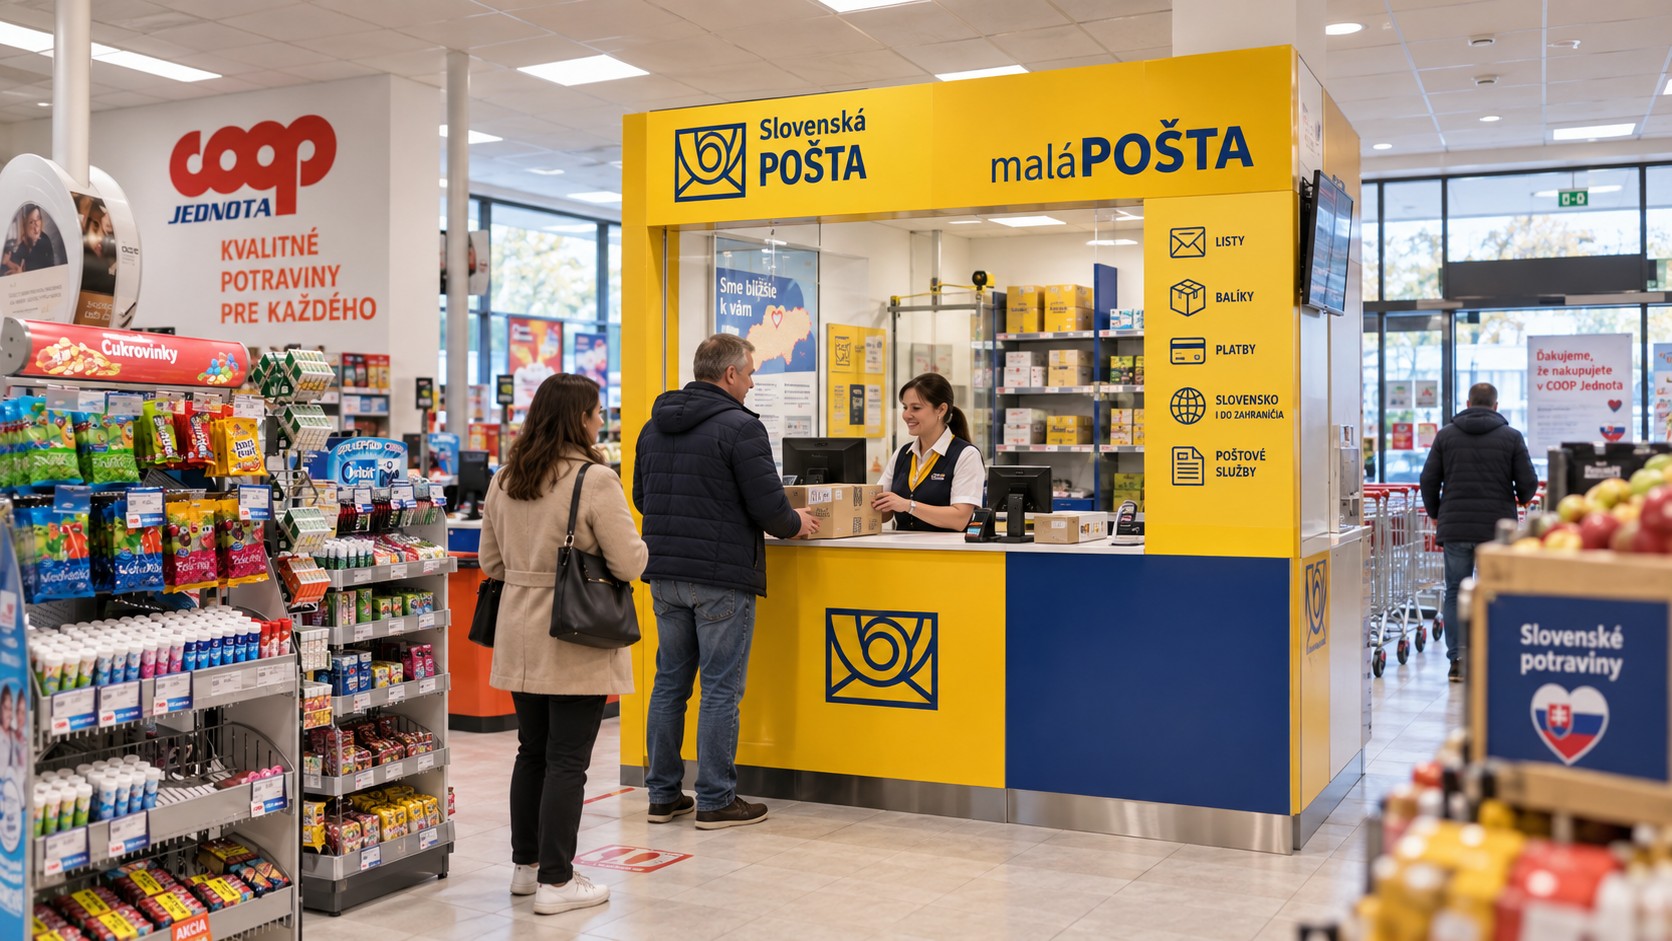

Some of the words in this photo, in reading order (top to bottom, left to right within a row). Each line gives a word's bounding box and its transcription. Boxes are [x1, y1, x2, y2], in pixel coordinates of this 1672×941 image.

[759, 108, 867, 141] Slovenská
[759, 140, 868, 187] POŠTA
[168, 198, 271, 225] JEDNOTA
[220, 227, 320, 262] KVALITNÉ
[1215, 235, 1245, 247] LISTY
[220, 264, 341, 293] POTRAVINY
[720, 276, 744, 295] Sme
[1215, 288, 1254, 303] BALÍKY
[220, 301, 260, 325] PRE
[266, 292, 378, 324] KAŽDÉHO
[720, 297, 728, 316] k
[101, 339, 178, 364] Cukrovinky
[1215, 344, 1256, 355] PLATBY
[1536, 365, 1549, 376] že
[1552, 364, 1613, 378] nakupujete
[1536, 382, 1544, 391] v
[1545, 380, 1577, 391] COOP
[1580, 380, 1624, 391] Jednota
[1215, 394, 1279, 406] SLOVENSKO
[1220, 410, 1233, 420] DO
[1215, 447, 1266, 462] POŠTOVÉ
[1215, 464, 1257, 478] SLUŽBY
[1519, 622, 1624, 650] Slovenské
[1520, 651, 1624, 682] potraviny
[176, 918, 208, 940] AKCIA
